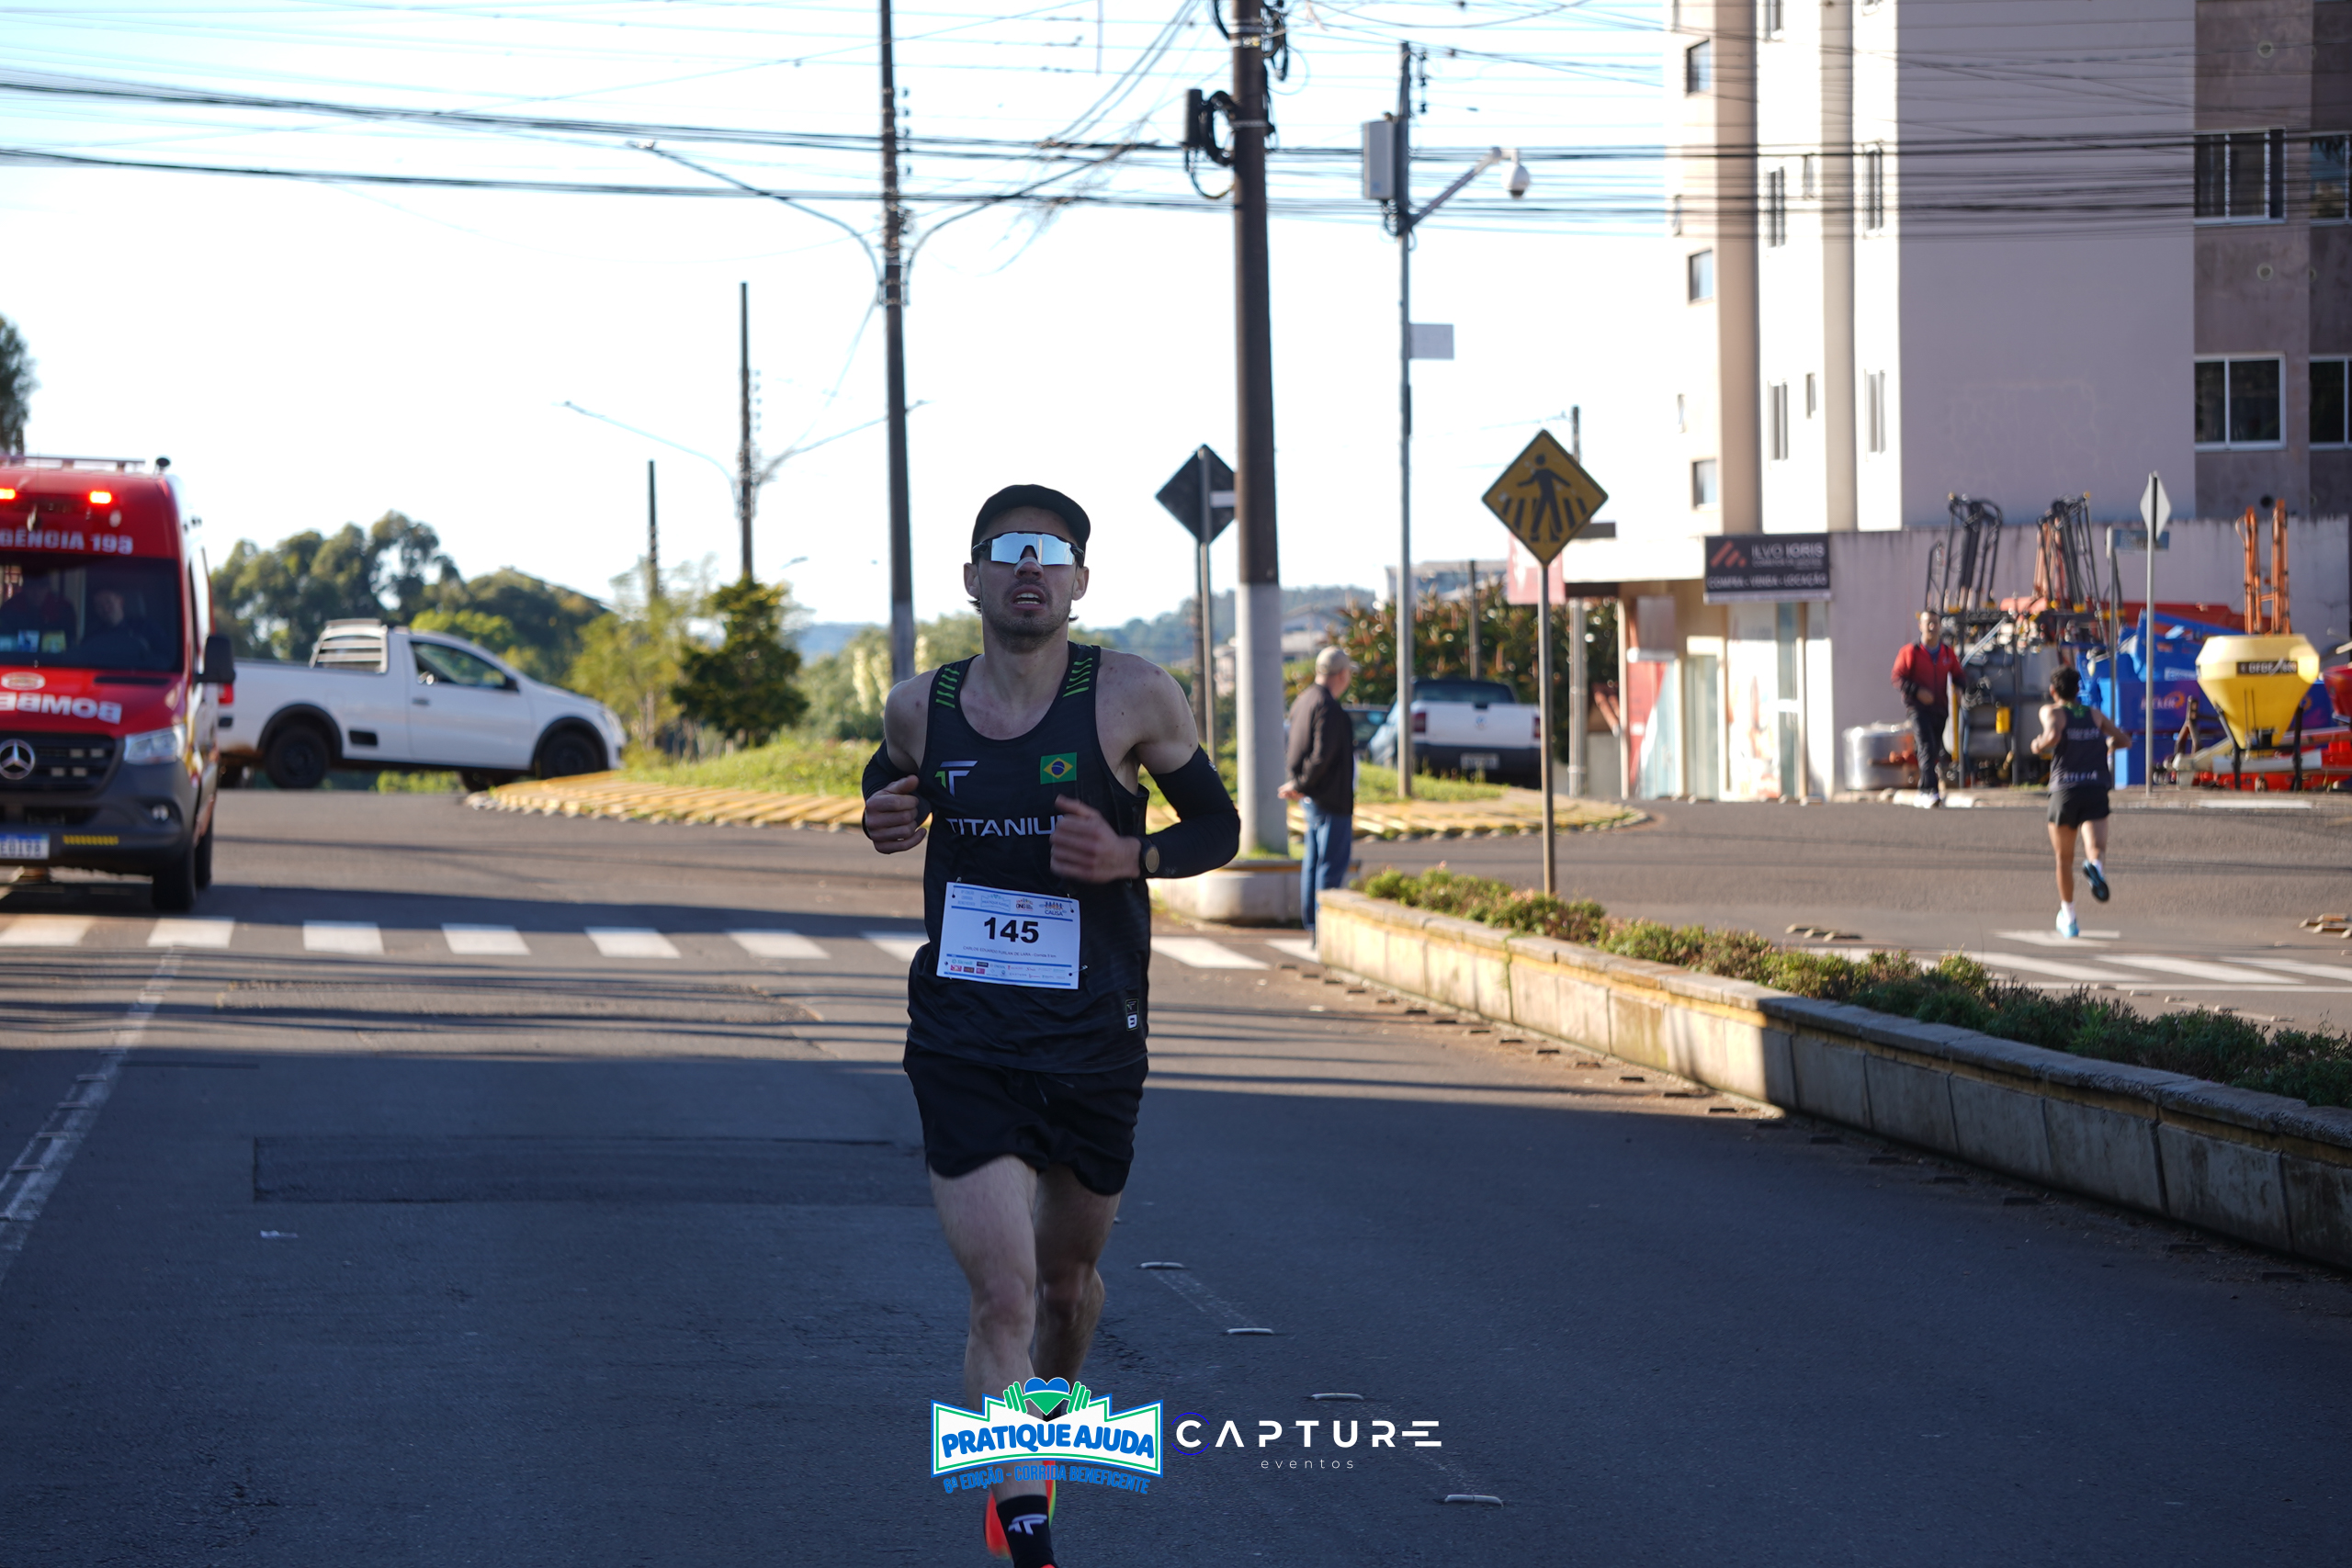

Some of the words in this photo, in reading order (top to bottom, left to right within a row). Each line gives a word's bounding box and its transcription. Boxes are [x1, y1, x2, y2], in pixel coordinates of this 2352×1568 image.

[1751, 543, 1783, 558] ILVO
[945, 815, 1066, 837] TITANIU
[984, 917, 1040, 943] 145
